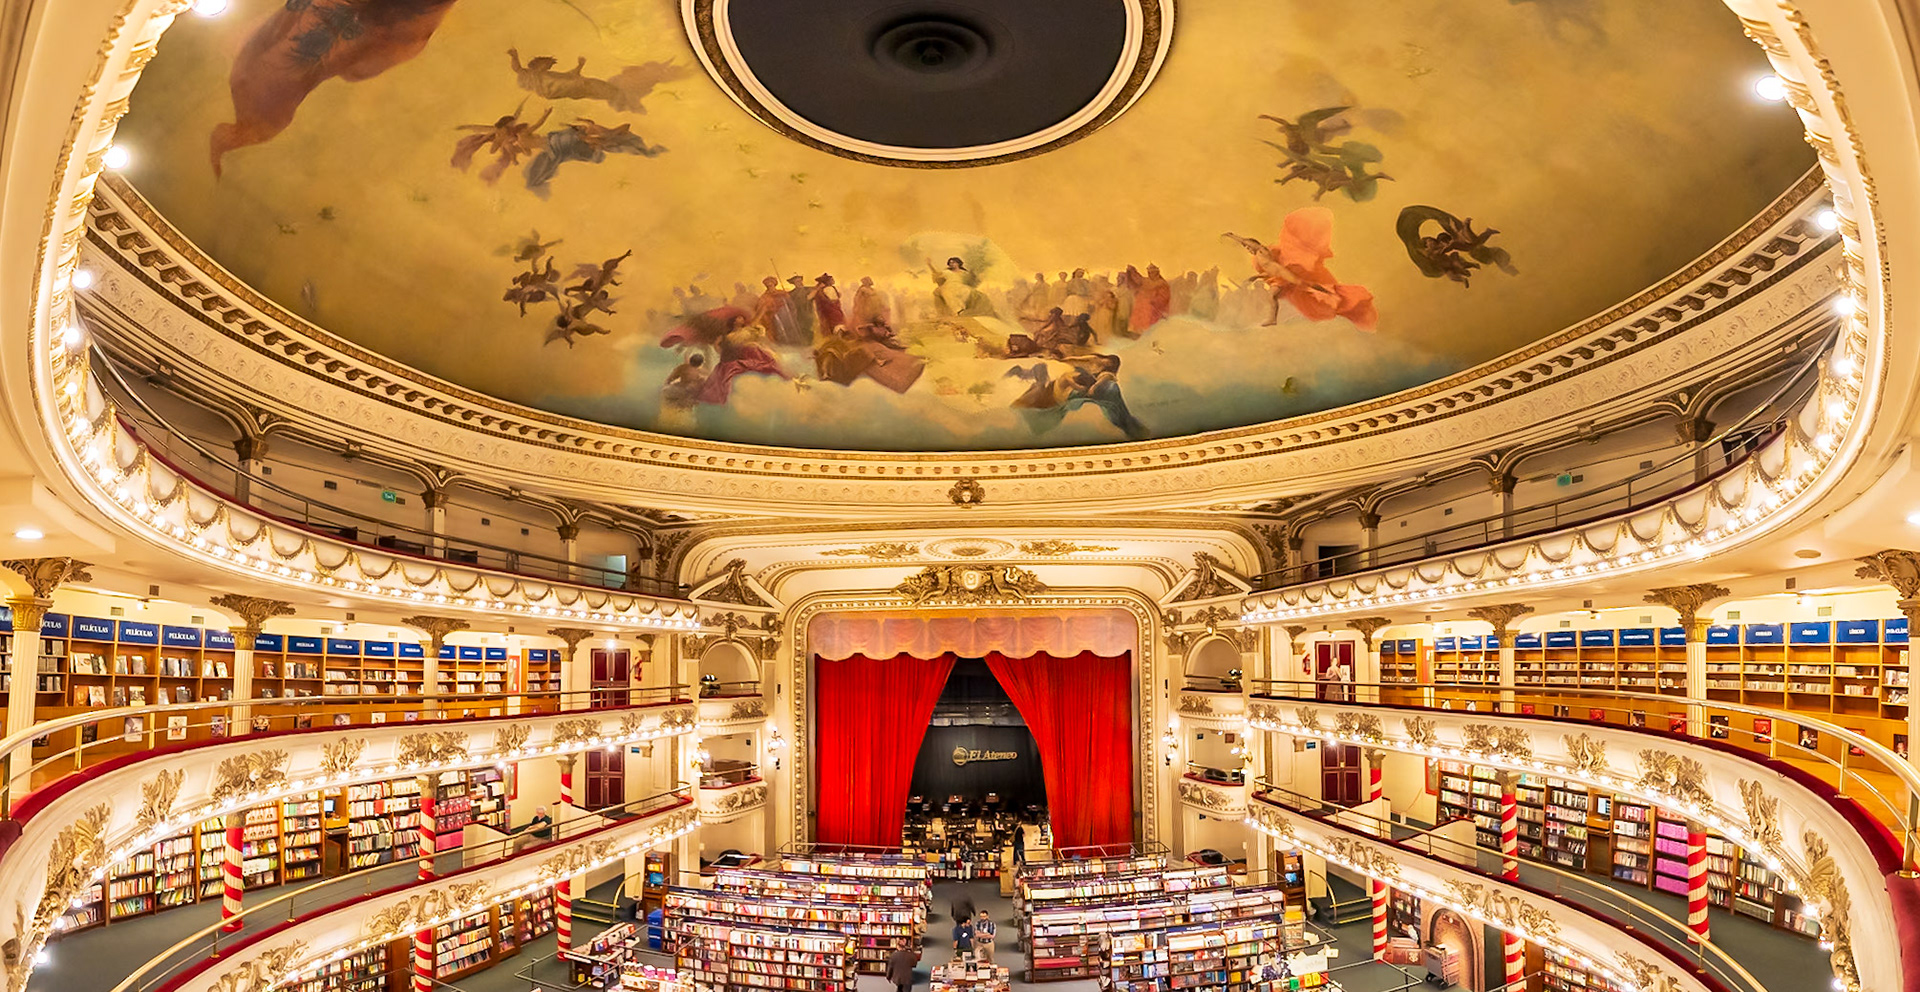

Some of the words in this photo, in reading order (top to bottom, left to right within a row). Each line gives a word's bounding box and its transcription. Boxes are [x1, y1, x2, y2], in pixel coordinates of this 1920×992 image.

[80, 624, 108, 633] PELÍCULAS
[125, 628, 153, 637] PELÍCULAS
[169, 632, 195, 641] PELÍCULAS
[211, 635, 235, 644] PELÍCULA
[969, 750, 981, 760] El
[982, 749, 1018, 760] Ateneo
